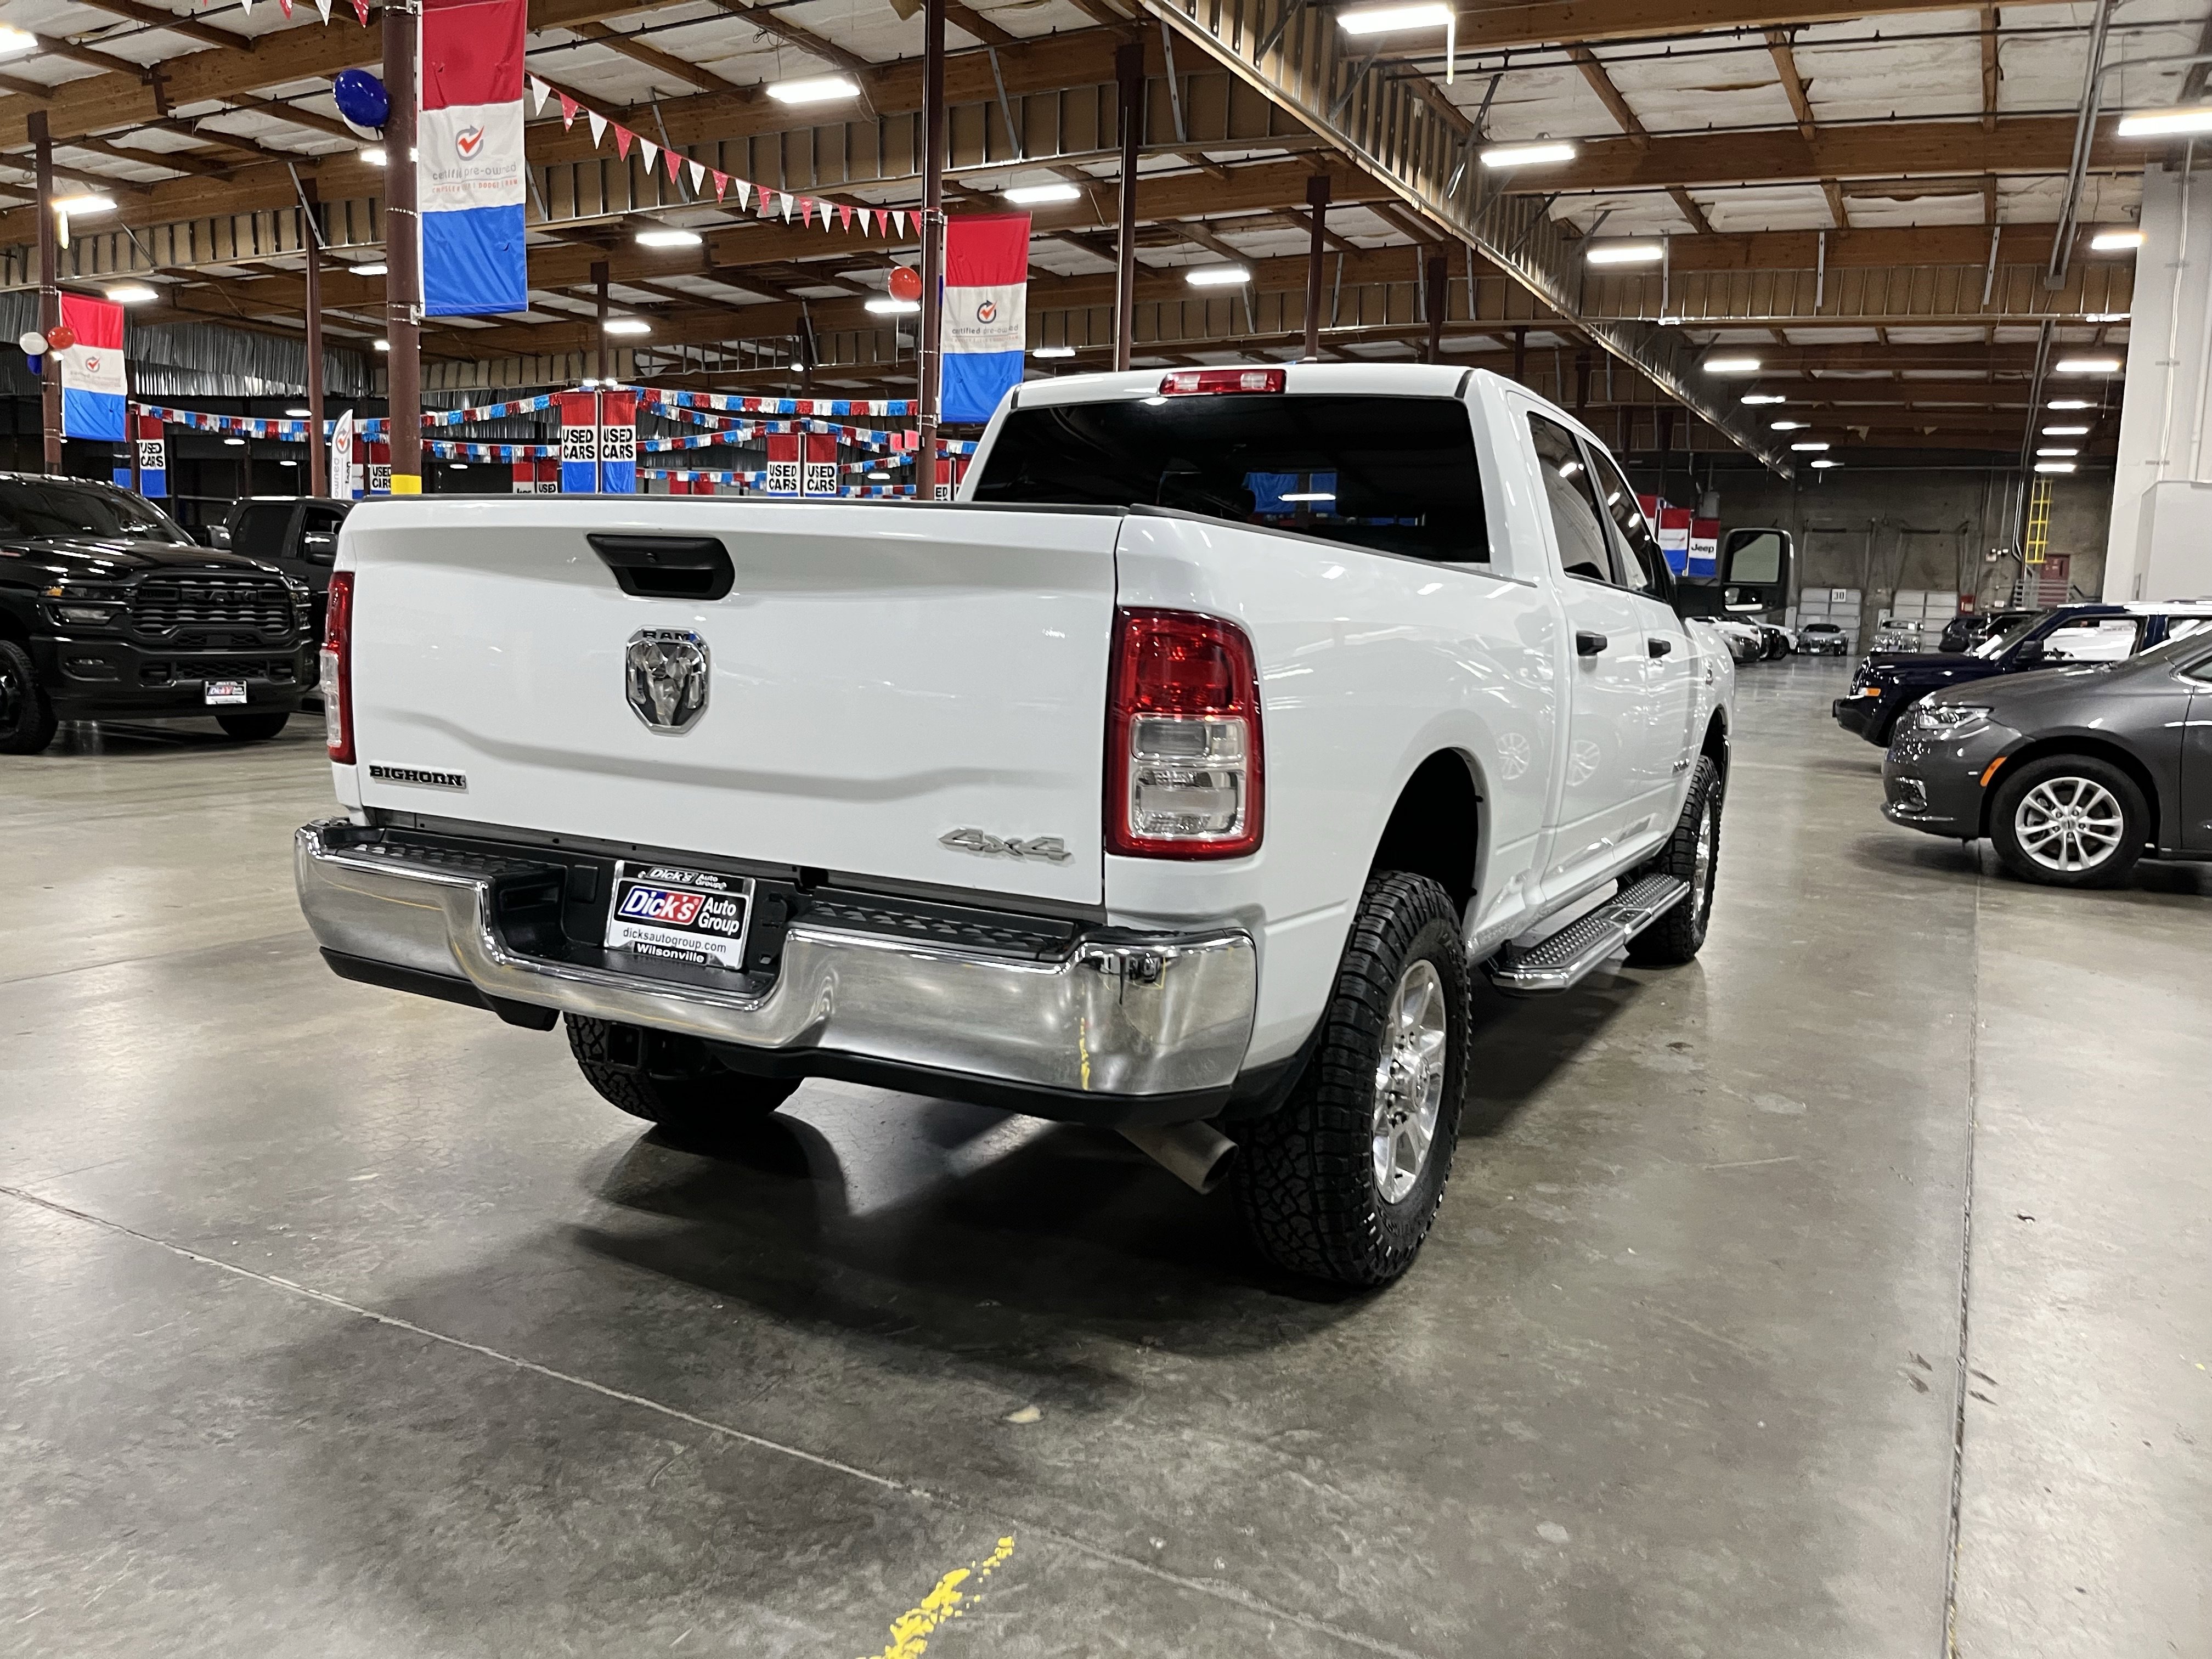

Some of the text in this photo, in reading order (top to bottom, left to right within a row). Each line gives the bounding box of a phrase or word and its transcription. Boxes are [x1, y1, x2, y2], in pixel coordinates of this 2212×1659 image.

[983, 324, 1019, 334] pre-owed
[563, 429, 594, 443] USED
[603, 428, 633, 443] USED
[140, 442, 162, 454] USED
[563, 445, 595, 459] CARS
[603, 444, 634, 459] CARS
[140, 455, 163, 467] CARS
[769, 464, 797, 477] USED
[808, 465, 835, 478] USED
[538, 483, 556, 493] USED
[769, 478, 797, 490] CARS
[807, 478, 835, 492] CARS
[935, 487, 948, 498] ED
[1691, 543, 1714, 554] Jeep
[643, 631, 690, 641] RAM
[369, 765, 462, 787] BIGHORN
[650, 869, 693, 883] Dick's
[698, 874, 719, 882] Auto
[624, 890, 695, 921] Dick's
[703, 896, 737, 917] Auto
[698, 912, 740, 936] Group
[623, 927, 727, 953] dicksautogroup.com
[636, 943, 705, 963] Wilsonville
